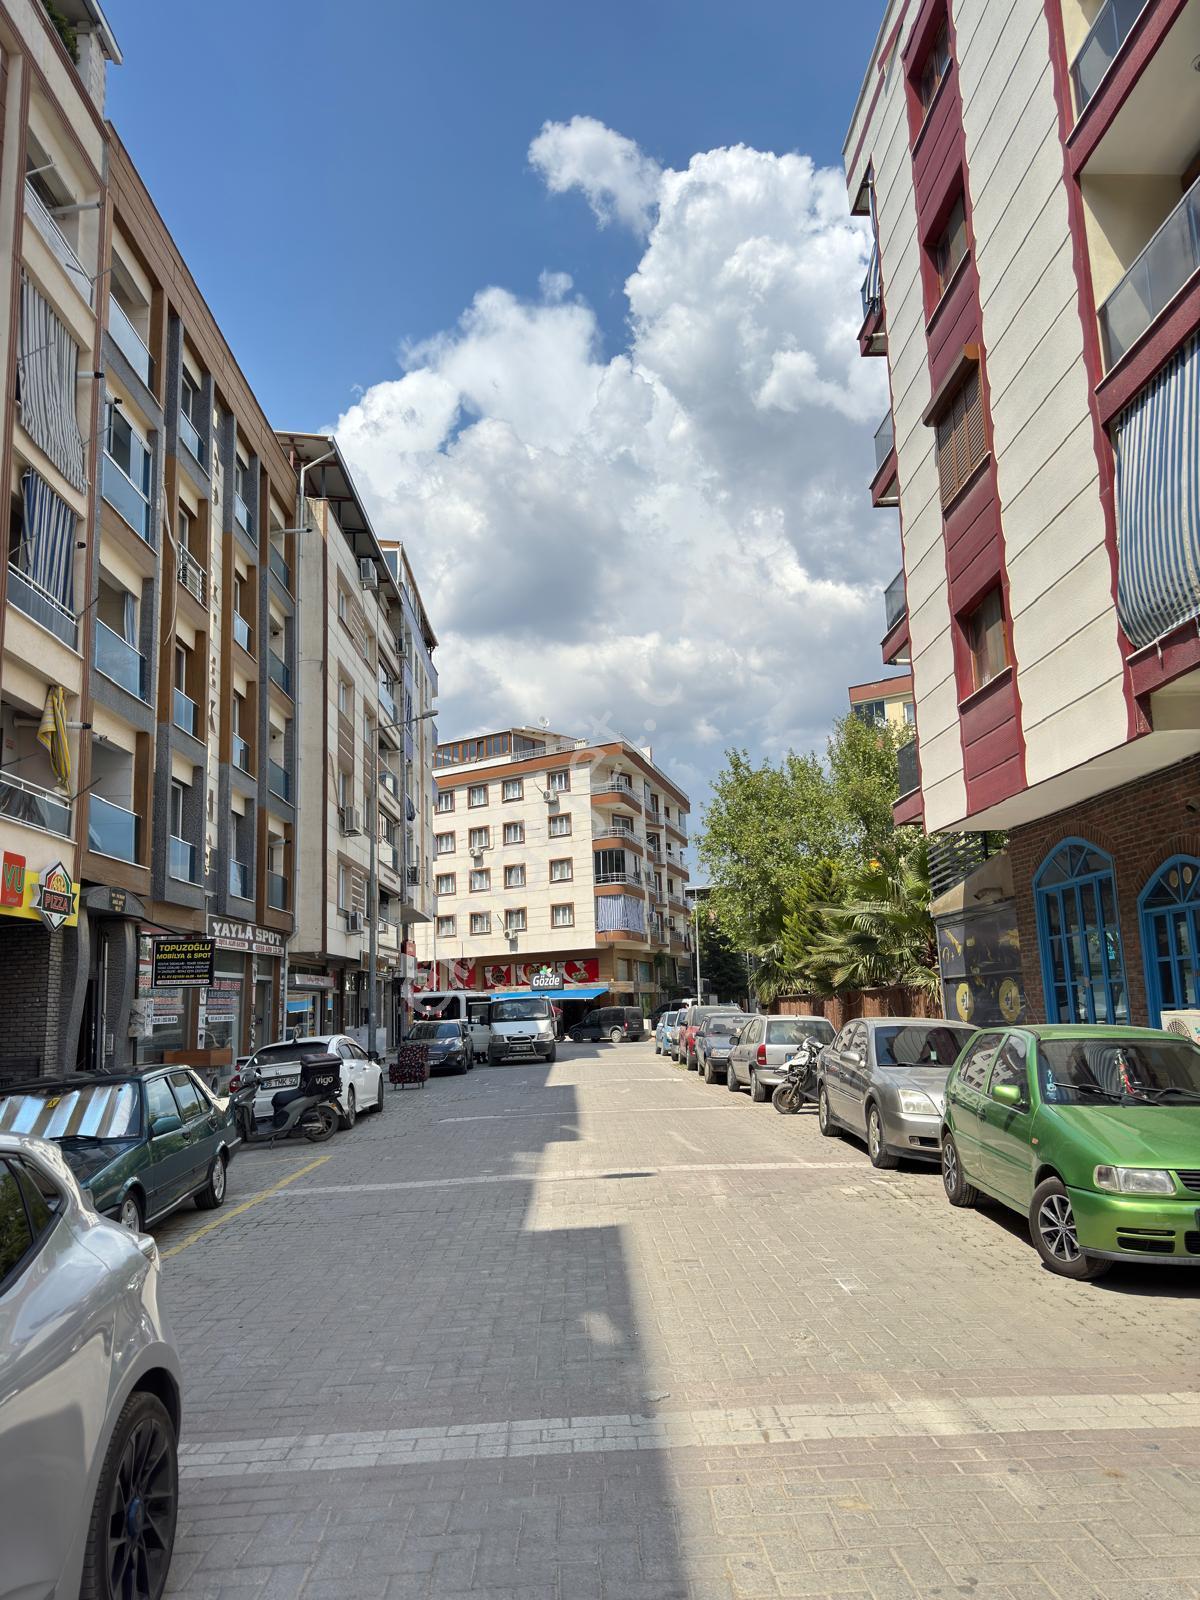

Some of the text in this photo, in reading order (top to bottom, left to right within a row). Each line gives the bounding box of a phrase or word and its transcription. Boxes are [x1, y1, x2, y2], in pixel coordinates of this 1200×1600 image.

[45, 893, 69, 912] PIZZA
[212, 922, 253, 940] YAYLA
[255, 928, 281, 945] SPOT
[160, 943, 211, 951] TOPUZOĞLU
[532, 975, 560, 986] Gözde
[315, 1075, 334, 1086] vigo
